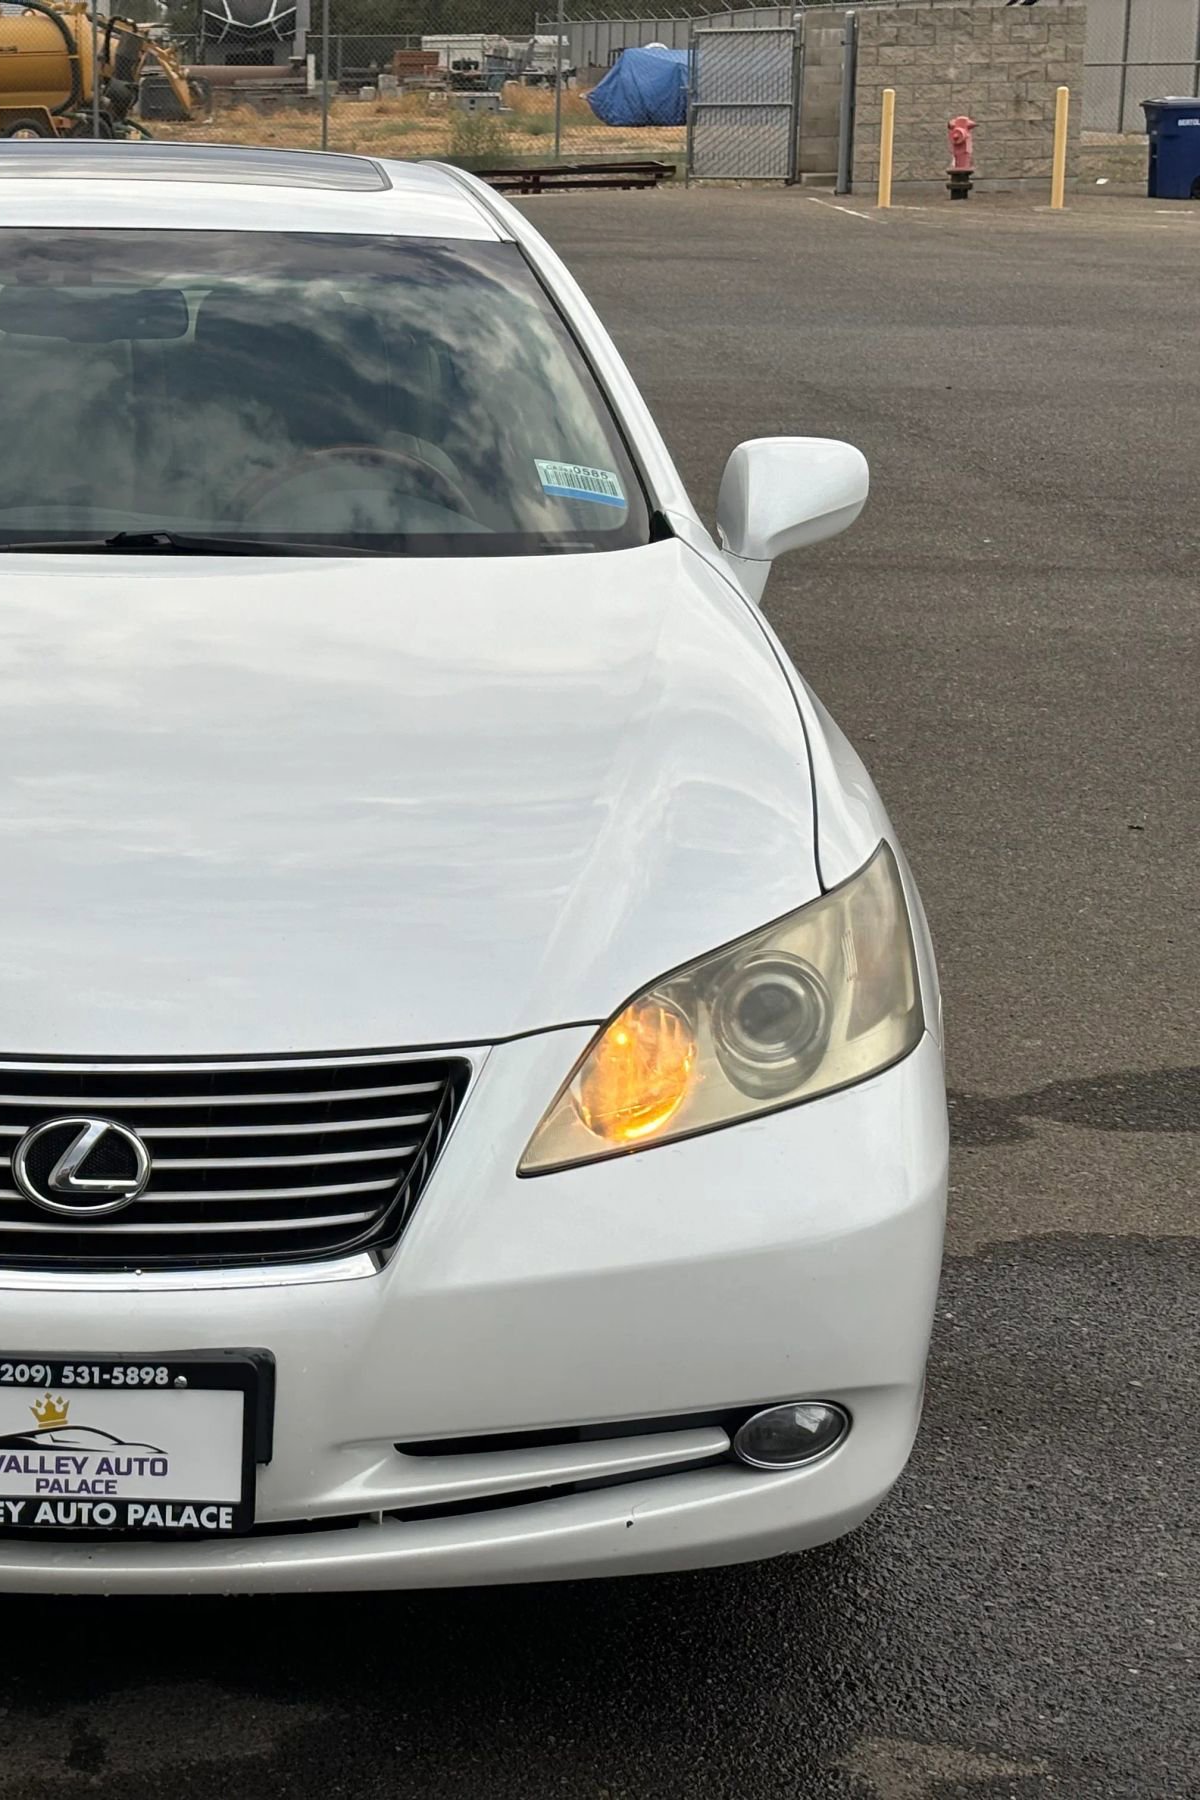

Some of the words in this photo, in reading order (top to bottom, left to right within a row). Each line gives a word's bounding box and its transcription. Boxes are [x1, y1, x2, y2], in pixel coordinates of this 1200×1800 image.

[573, 466, 608, 480] 0585
[61, 1366, 168, 1385] 531-5898
[95, 1457, 168, 1476] AUTO
[35, 1478, 117, 1495] PALACE
[34, 1502, 117, 1526] AUTO
[127, 1504, 232, 1529] PALACE
